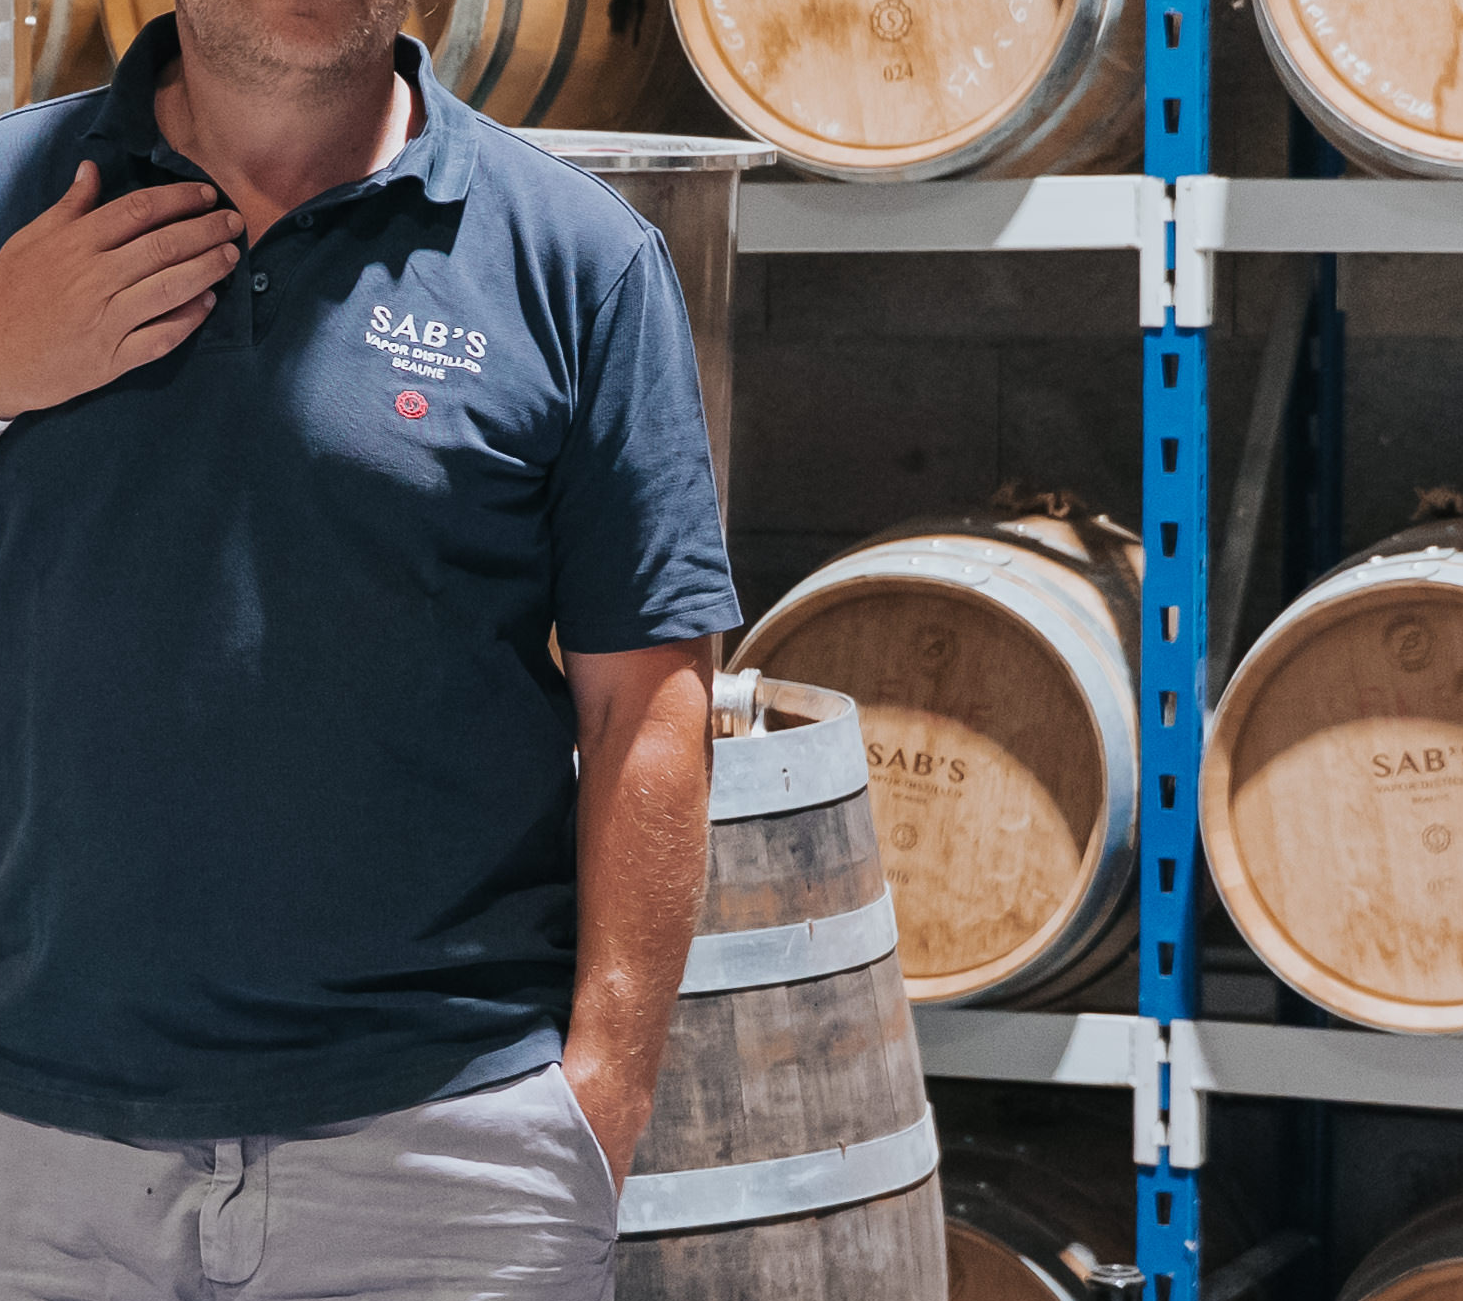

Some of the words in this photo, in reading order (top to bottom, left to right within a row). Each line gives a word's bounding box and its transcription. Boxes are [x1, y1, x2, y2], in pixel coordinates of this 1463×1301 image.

[883, 62, 914, 83] 024
[364, 331, 410, 357] VAPOR
[412, 347, 482, 374] DISTILLED
[370, 304, 488, 359] SAB'S
[391, 356, 447, 381] BEAUNE
[866, 742, 966, 784] SAB'S
